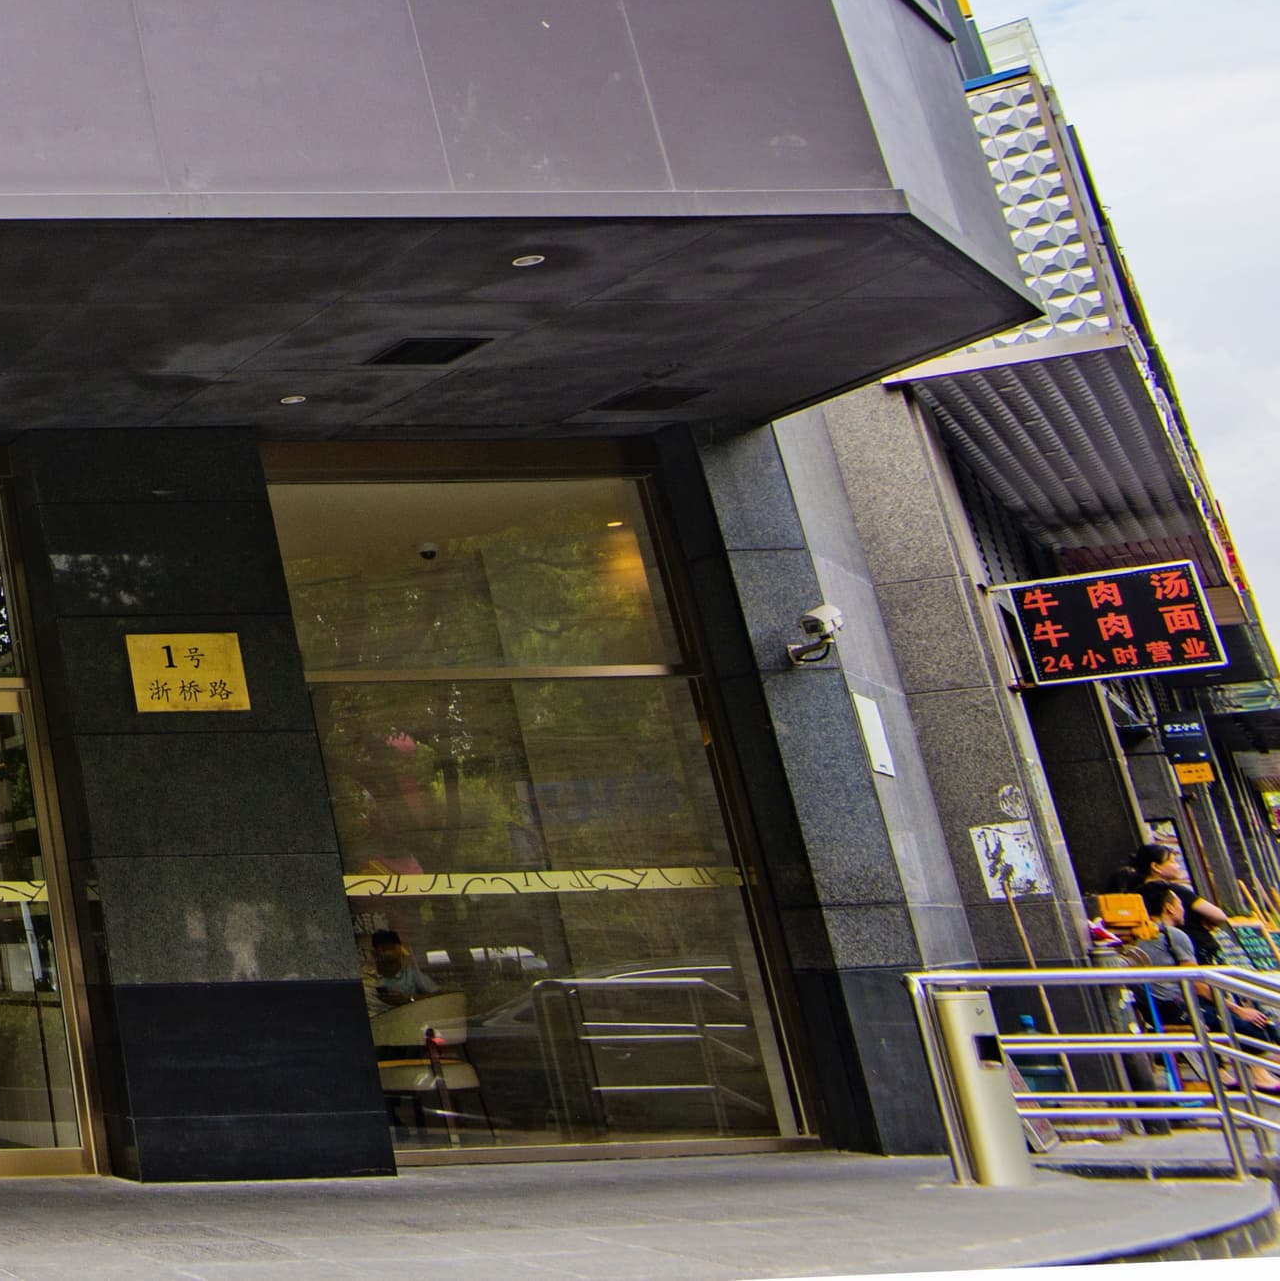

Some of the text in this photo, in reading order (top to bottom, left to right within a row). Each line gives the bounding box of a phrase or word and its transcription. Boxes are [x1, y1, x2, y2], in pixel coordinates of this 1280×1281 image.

[1023, 571, 1189, 616] 牛肉汤
[1033, 603, 1201, 648] 牛肉面
[161, 644, 205, 669] 1号
[1042, 638, 1210, 673] 24小时营业
